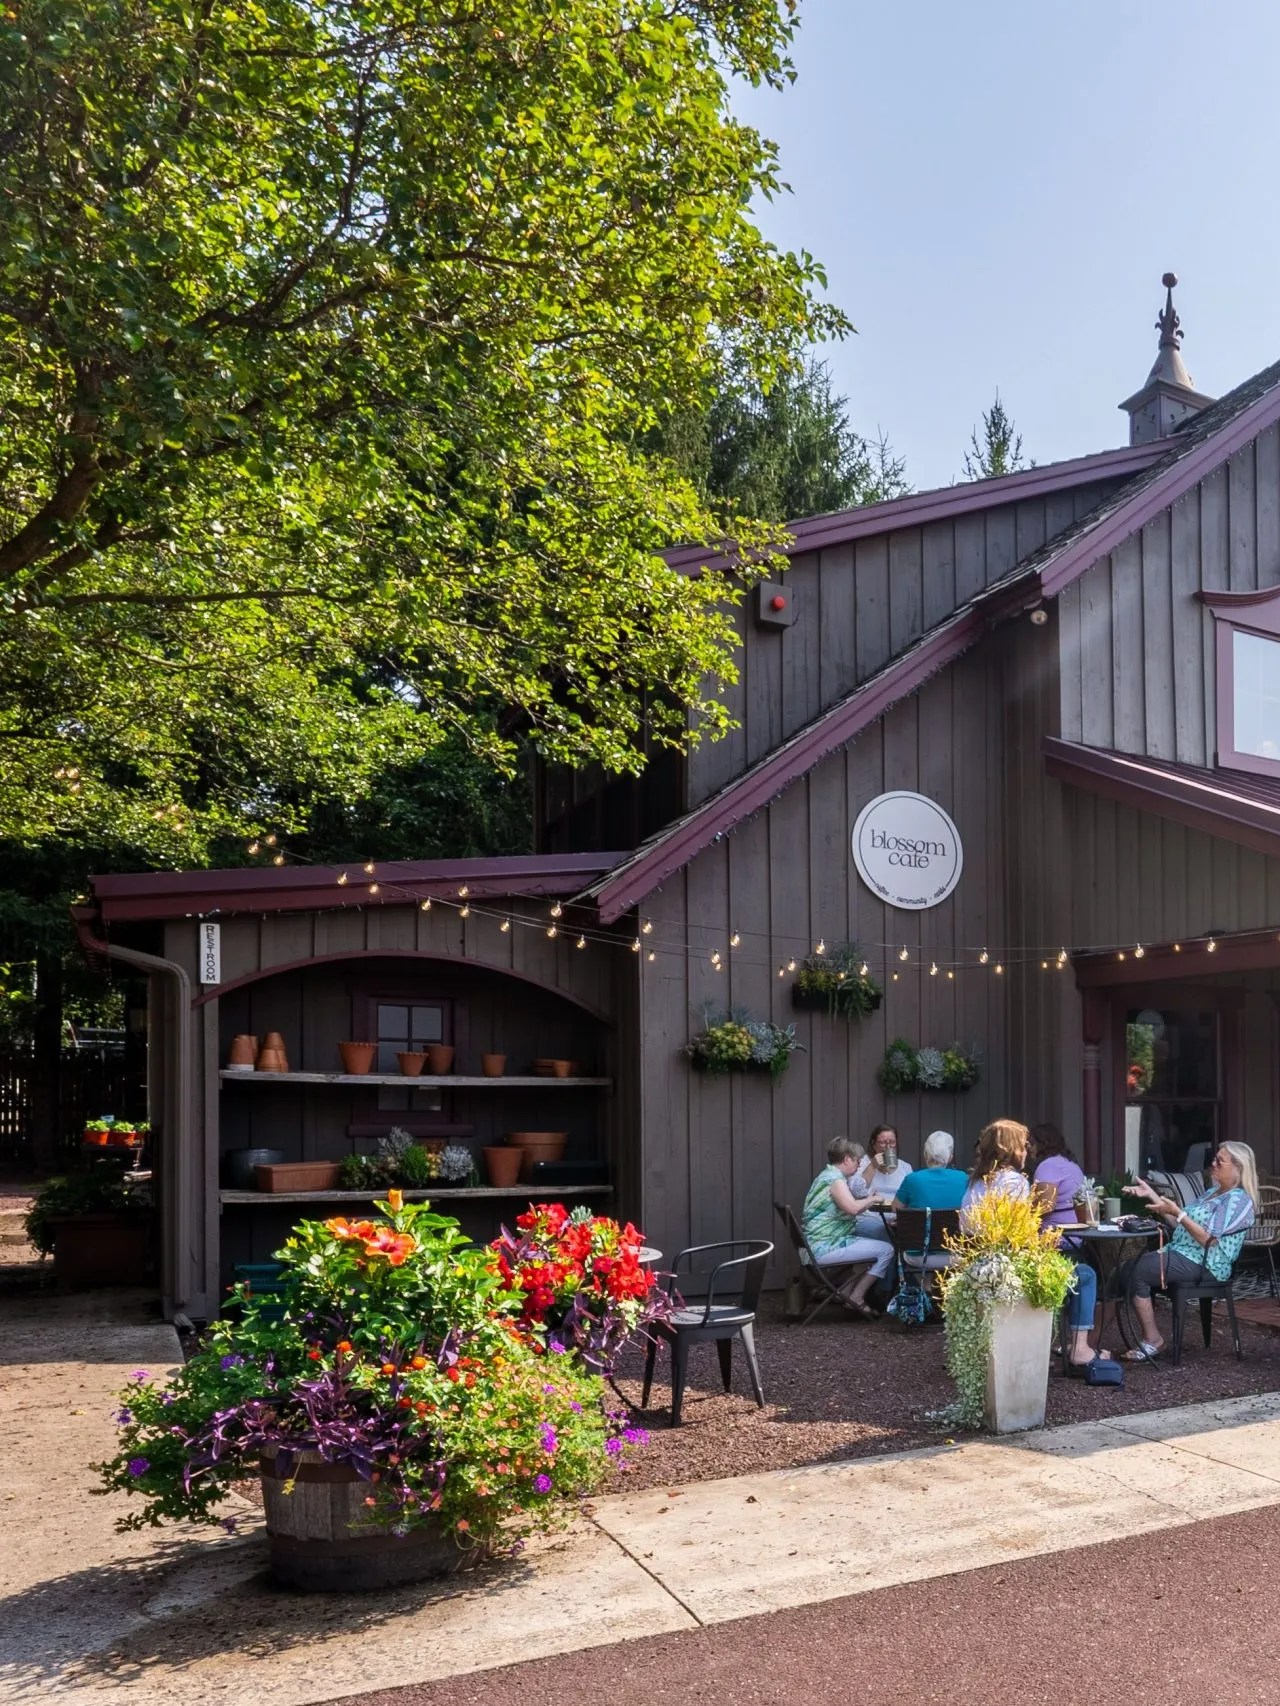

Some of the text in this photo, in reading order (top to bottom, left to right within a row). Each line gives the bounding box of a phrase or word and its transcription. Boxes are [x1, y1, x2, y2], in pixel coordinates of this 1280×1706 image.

[871, 829, 947, 857] blossom
[888, 850, 930, 869] cafe
[206, 925, 216, 981] RESTROOM
